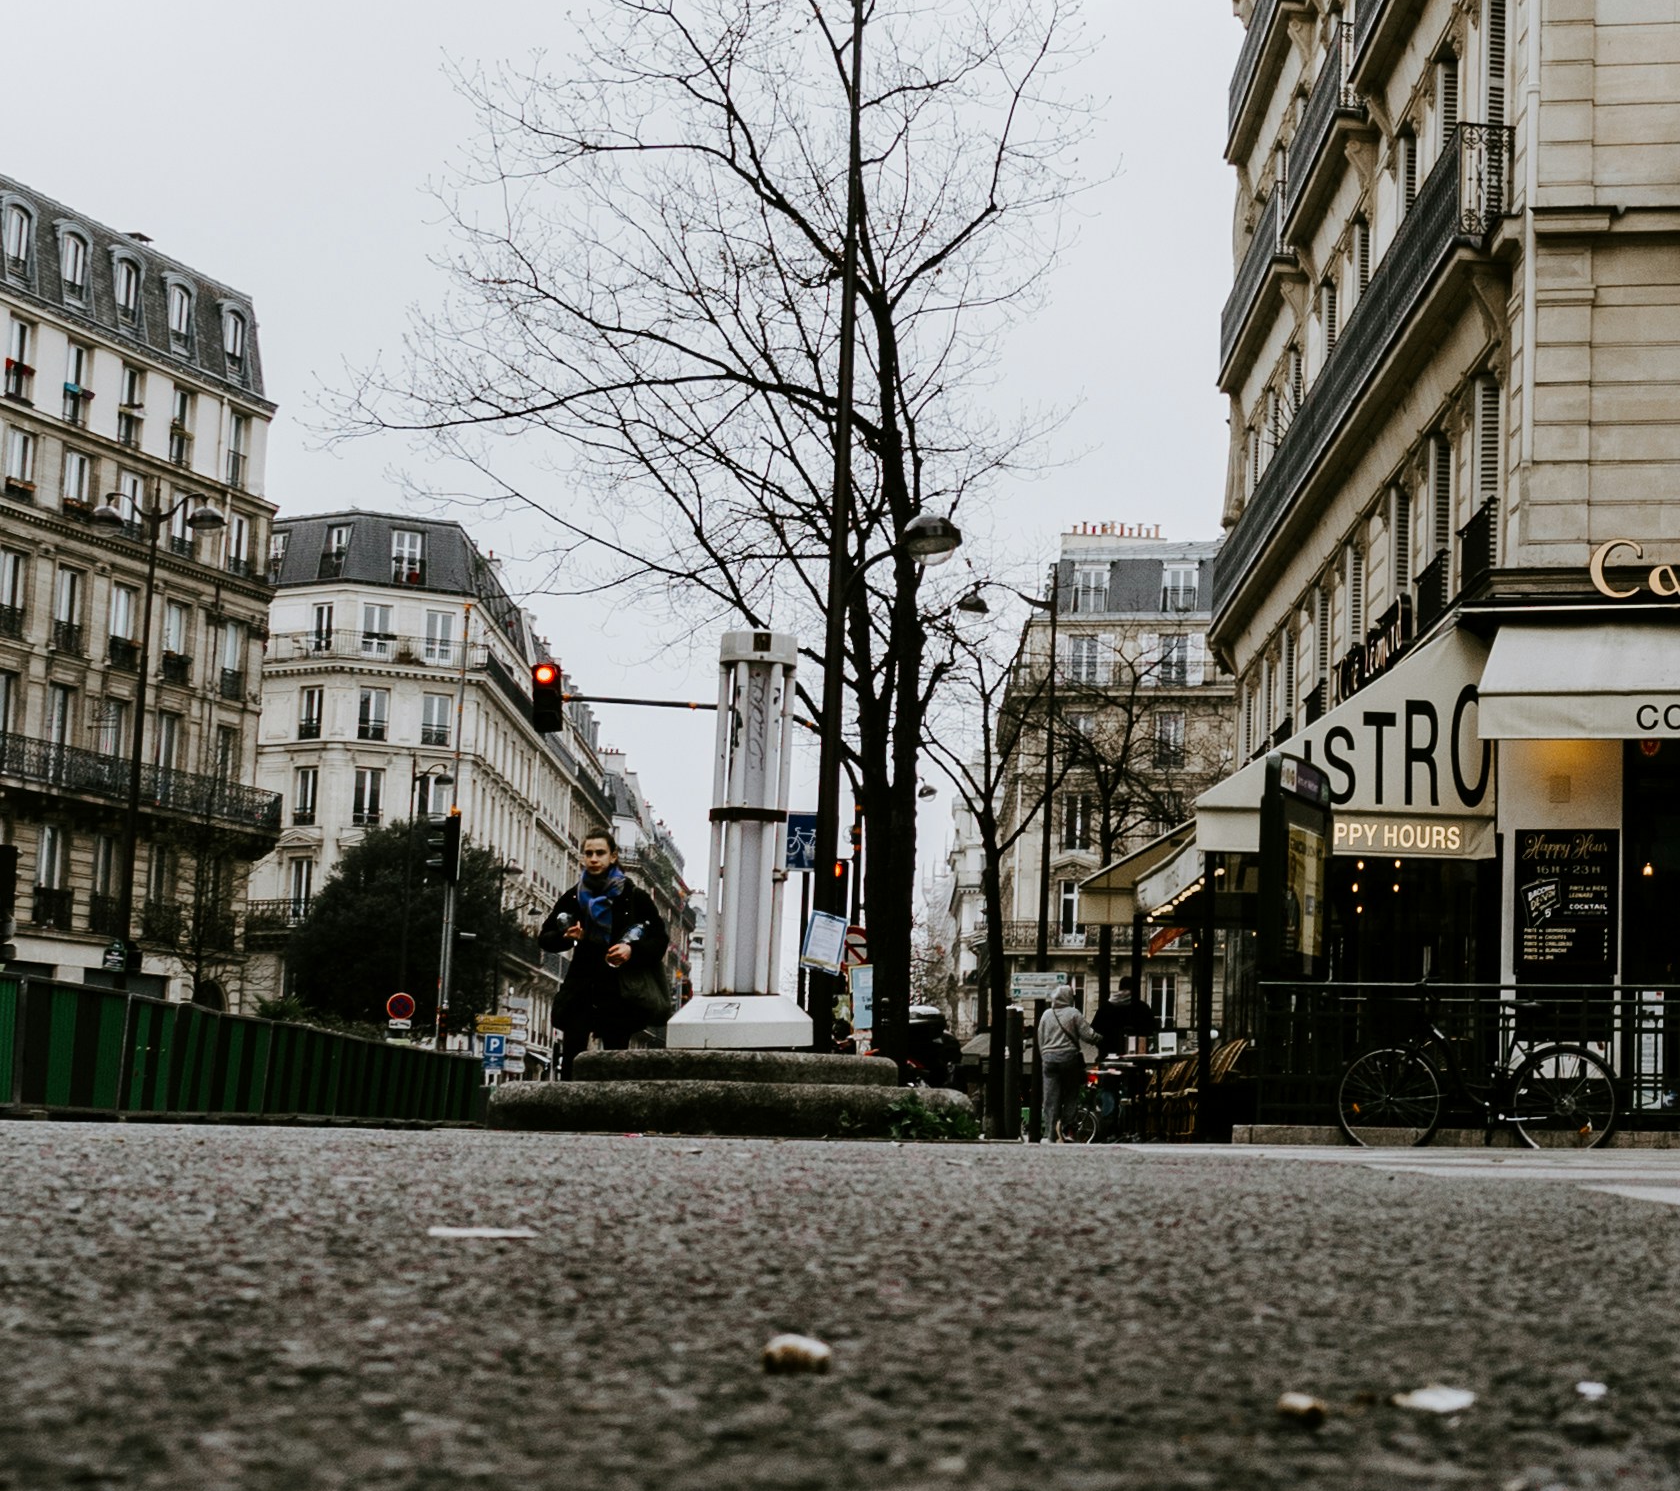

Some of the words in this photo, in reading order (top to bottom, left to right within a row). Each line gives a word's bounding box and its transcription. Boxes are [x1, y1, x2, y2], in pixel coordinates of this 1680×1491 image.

[1333, 820, 1377, 850] PPY
[1383, 823, 1461, 850] HOURS
[1522, 833, 1571, 859] Happy
[1571, 832, 1608, 859] Hour
[489, 1037, 501, 1052] P
